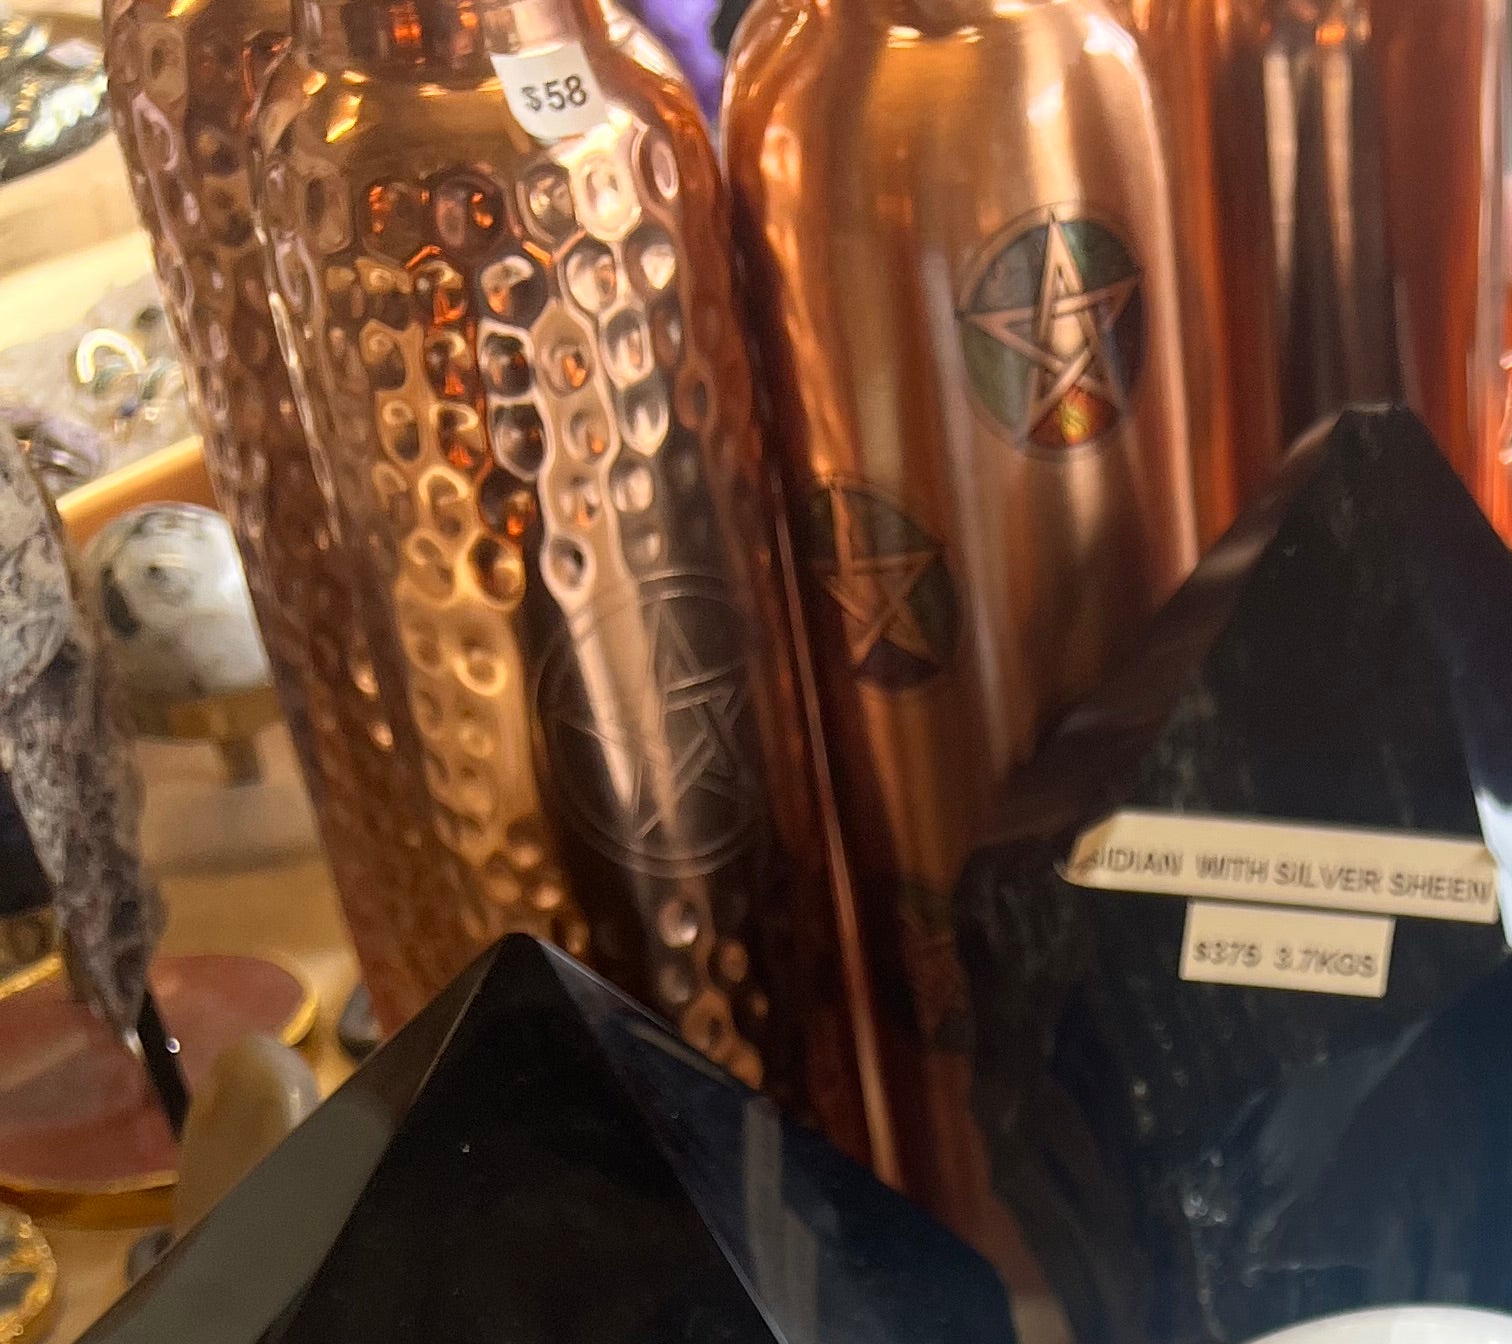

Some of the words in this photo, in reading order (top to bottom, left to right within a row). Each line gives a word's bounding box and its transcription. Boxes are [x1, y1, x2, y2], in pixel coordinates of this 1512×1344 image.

[520, 73, 588, 112] $58
[1195, 852, 1270, 884] WITH
[1274, 860, 1384, 894] SILVER
[1388, 870, 1494, 905] SHEEN
[1192, 941, 1262, 968] $375
[1273, 945, 1378, 979] 3.7KGS
